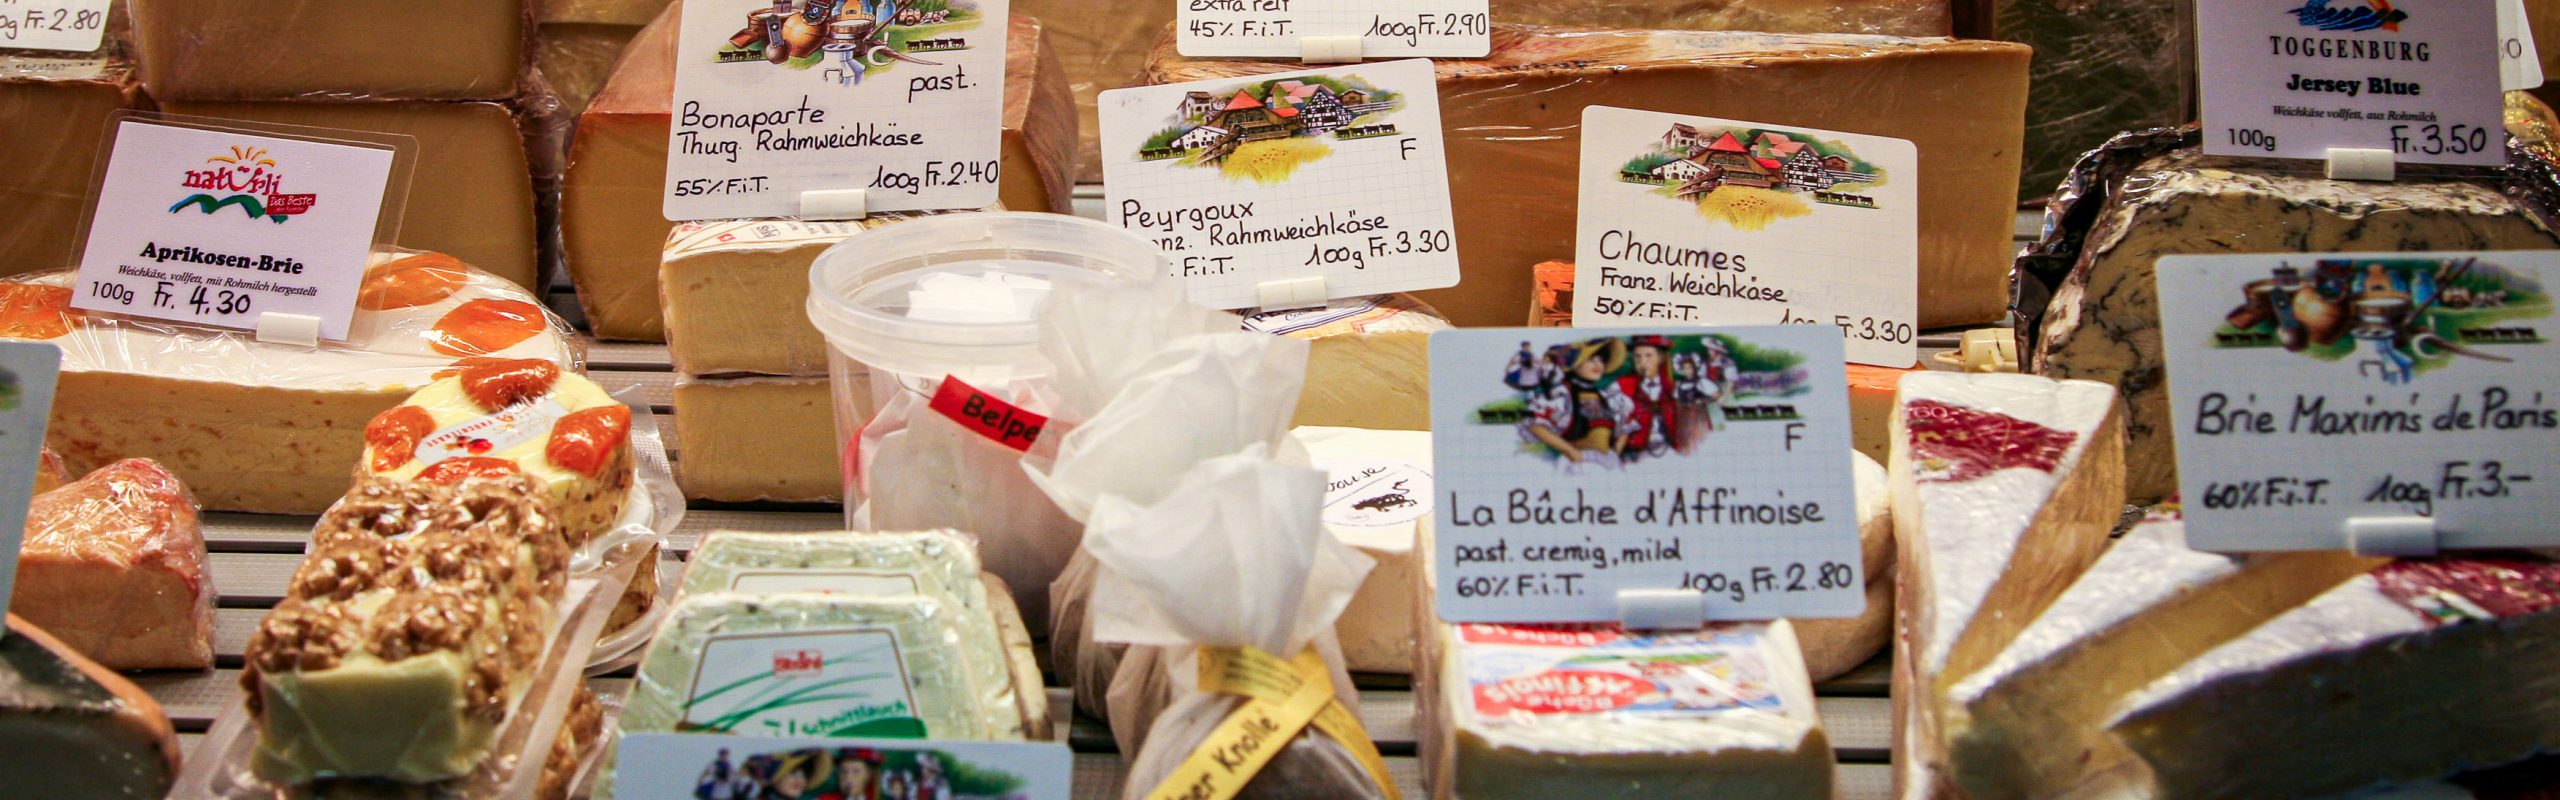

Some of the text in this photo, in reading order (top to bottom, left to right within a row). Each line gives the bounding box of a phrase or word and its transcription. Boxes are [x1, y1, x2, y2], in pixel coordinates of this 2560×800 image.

[2269, 35, 2431, 62] TOGGENBURG
[908, 63, 978, 104] past.
[2286, 73, 2421, 97] Jersey Blue
[680, 94, 825, 136] Bonaparte
[2272, 104, 2325, 119] Weichkäse
[2366, 110, 2385, 121] aus
[2387, 110, 2437, 123] Rohmilch
[756, 122, 925, 152] Rahmweichkäse
[1400, 138, 1417, 161] F
[2227, 127, 2276, 151] 100g
[181, 164, 283, 196] natürli
[868, 164, 920, 195] 100g
[287, 195, 314, 206] Beste
[1121, 198, 1255, 231] Peyrgoux
[1209, 210, 1390, 247] Rahmweichkäse
[139, 240, 305, 275] Aprikosen-Brie
[1304, 243, 1365, 270] 100g
[1599, 229, 1747, 274] Chaumes
[90, 280, 135, 306] 100g
[153, 280, 176, 311] Fr.
[117, 263, 168, 282] Weichkäse,
[205, 275, 224, 288] mit
[225, 277, 271, 293] Rohmilch
[270, 283, 319, 299] hergestellt
[1669, 270, 1789, 304] Weichkäse
[2194, 391, 2278, 436] Brie
[2431, 394, 2477, 432] de
[2479, 386, 2560, 431] Paris
[1784, 422, 1806, 451] F
[1450, 486, 1826, 527] La Bûche d'Affinoise
[1676, 570, 1744, 602] 100g
